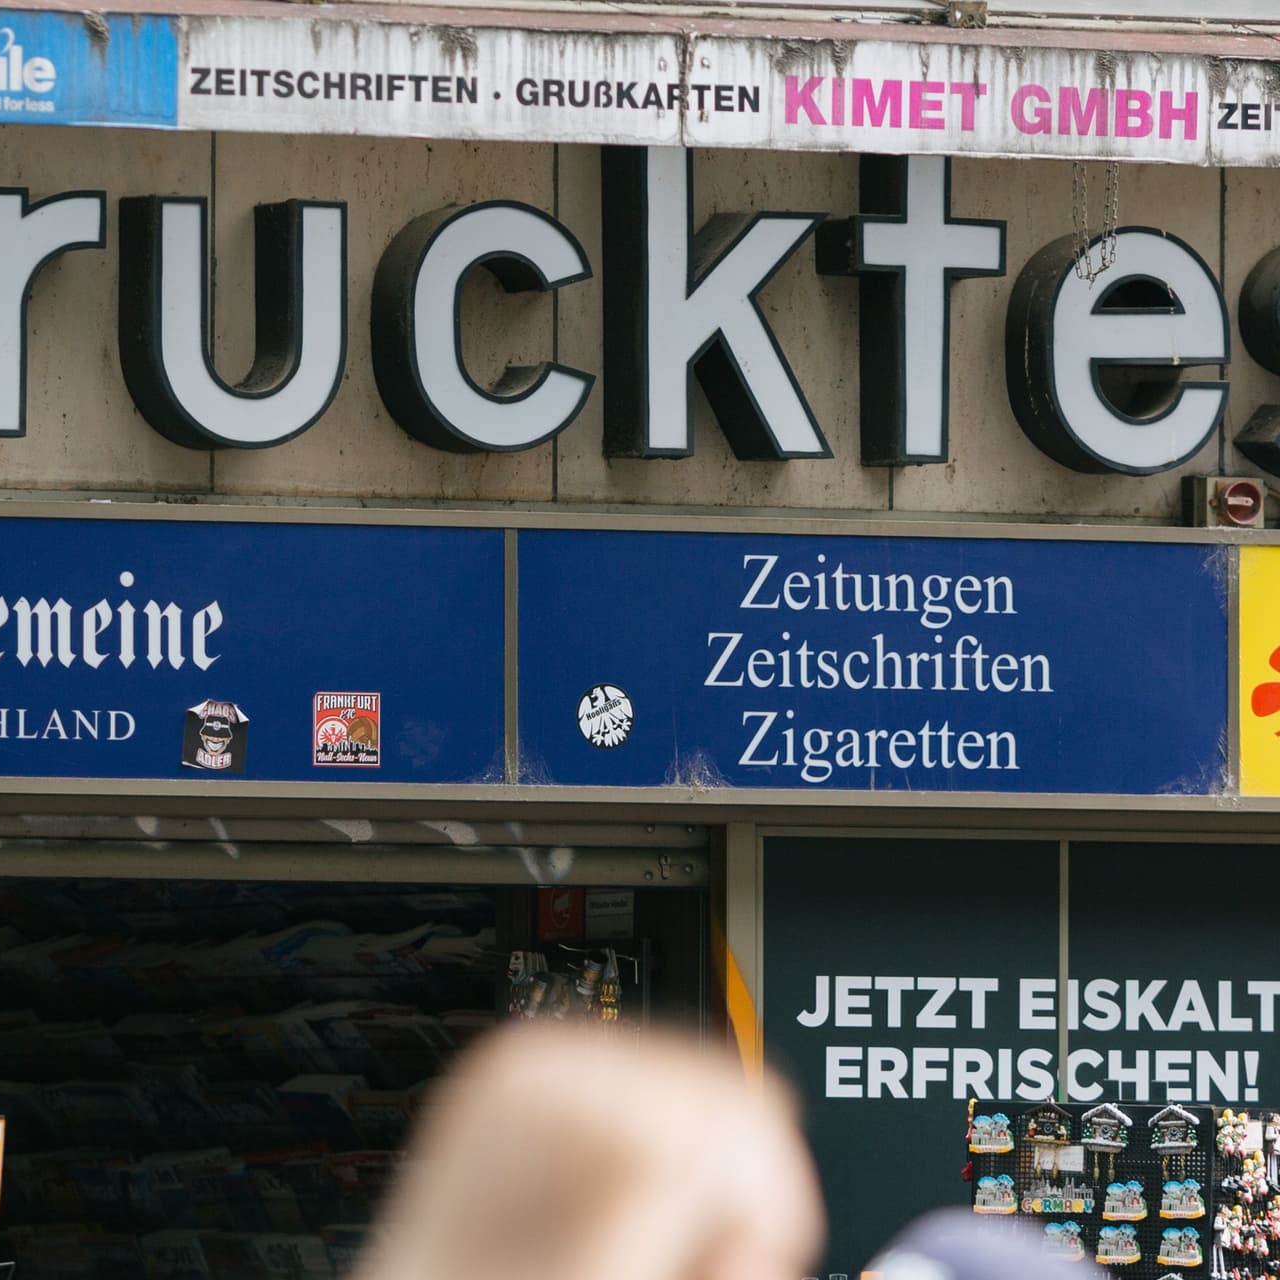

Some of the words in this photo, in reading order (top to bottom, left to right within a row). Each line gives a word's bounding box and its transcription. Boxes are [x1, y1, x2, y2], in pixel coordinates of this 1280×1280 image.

[190, 66, 478, 105] ZEITSCHRIFTEN
[515, 77, 760, 113] GRUßKARTEN
[784, 75, 987, 132] KIMET
[1010, 85, 1199, 141] GMBH
[739, 554, 1018, 629] Zeitungen
[704, 632, 1054, 693] Zeitschriften
[316, 695, 377, 712] FRANKFURT
[585, 699, 622, 721] Hooligans
[738, 710, 1020, 783] Zigaretten
[795, 975, 1000, 1029] JETZT
[824, 1045, 1261, 1103] ERFRISCHEN!
